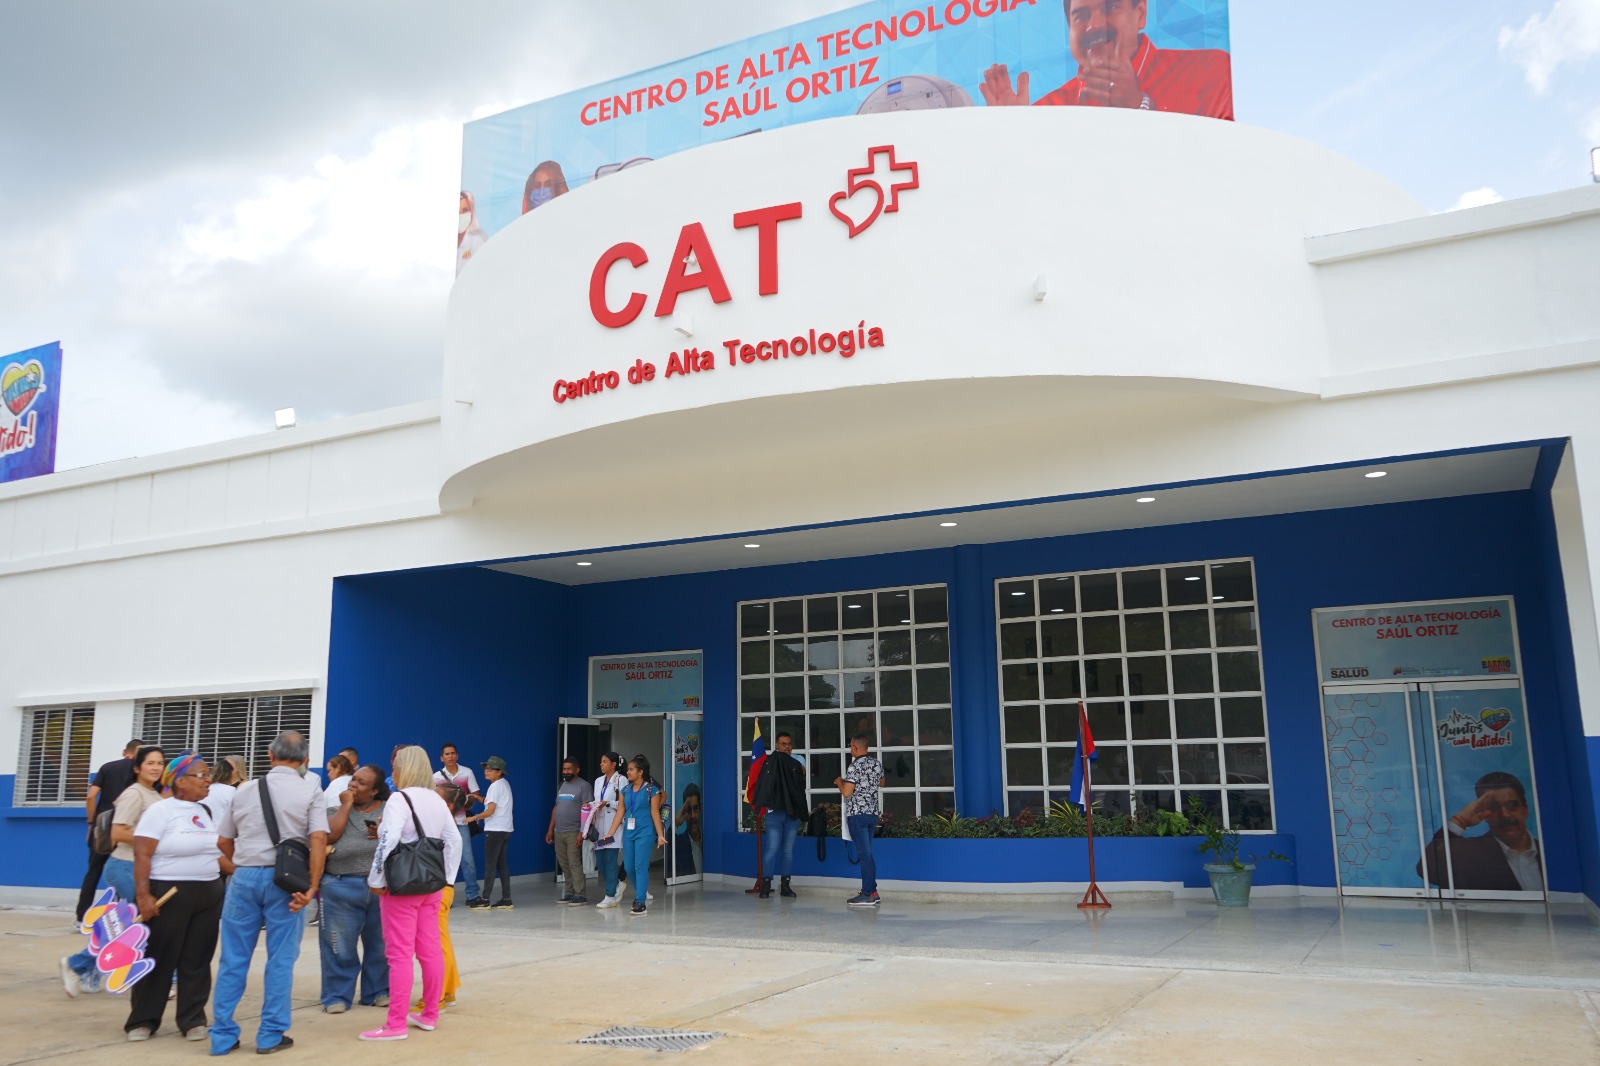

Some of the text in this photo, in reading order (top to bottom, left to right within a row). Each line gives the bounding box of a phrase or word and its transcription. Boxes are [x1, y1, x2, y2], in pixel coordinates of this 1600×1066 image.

[579, 77, 689, 127] CENTRO
[694, 62, 730, 98] DE
[736, 41, 811, 85] ALTA
[702, 56, 881, 127] SAÚL ORTIZ
[588, 201, 803, 330] CAT
[552, 319, 886, 404] Centro de Alta Tecnología
[1331, 607, 1502, 629] CENTRO DE ALTA TECNOLOGÍA
[1376, 623, 1460, 640] SAÚL ORTIZ
[601, 663, 626, 671] CENTRO
[627, 662, 637, 670] DE
[636, 661, 654, 669] ALTA
[625, 669, 673, 680] SAÚL ORTIZ
[1330, 668, 1370, 679] SALUD
[595, 702, 619, 710] SALUD
